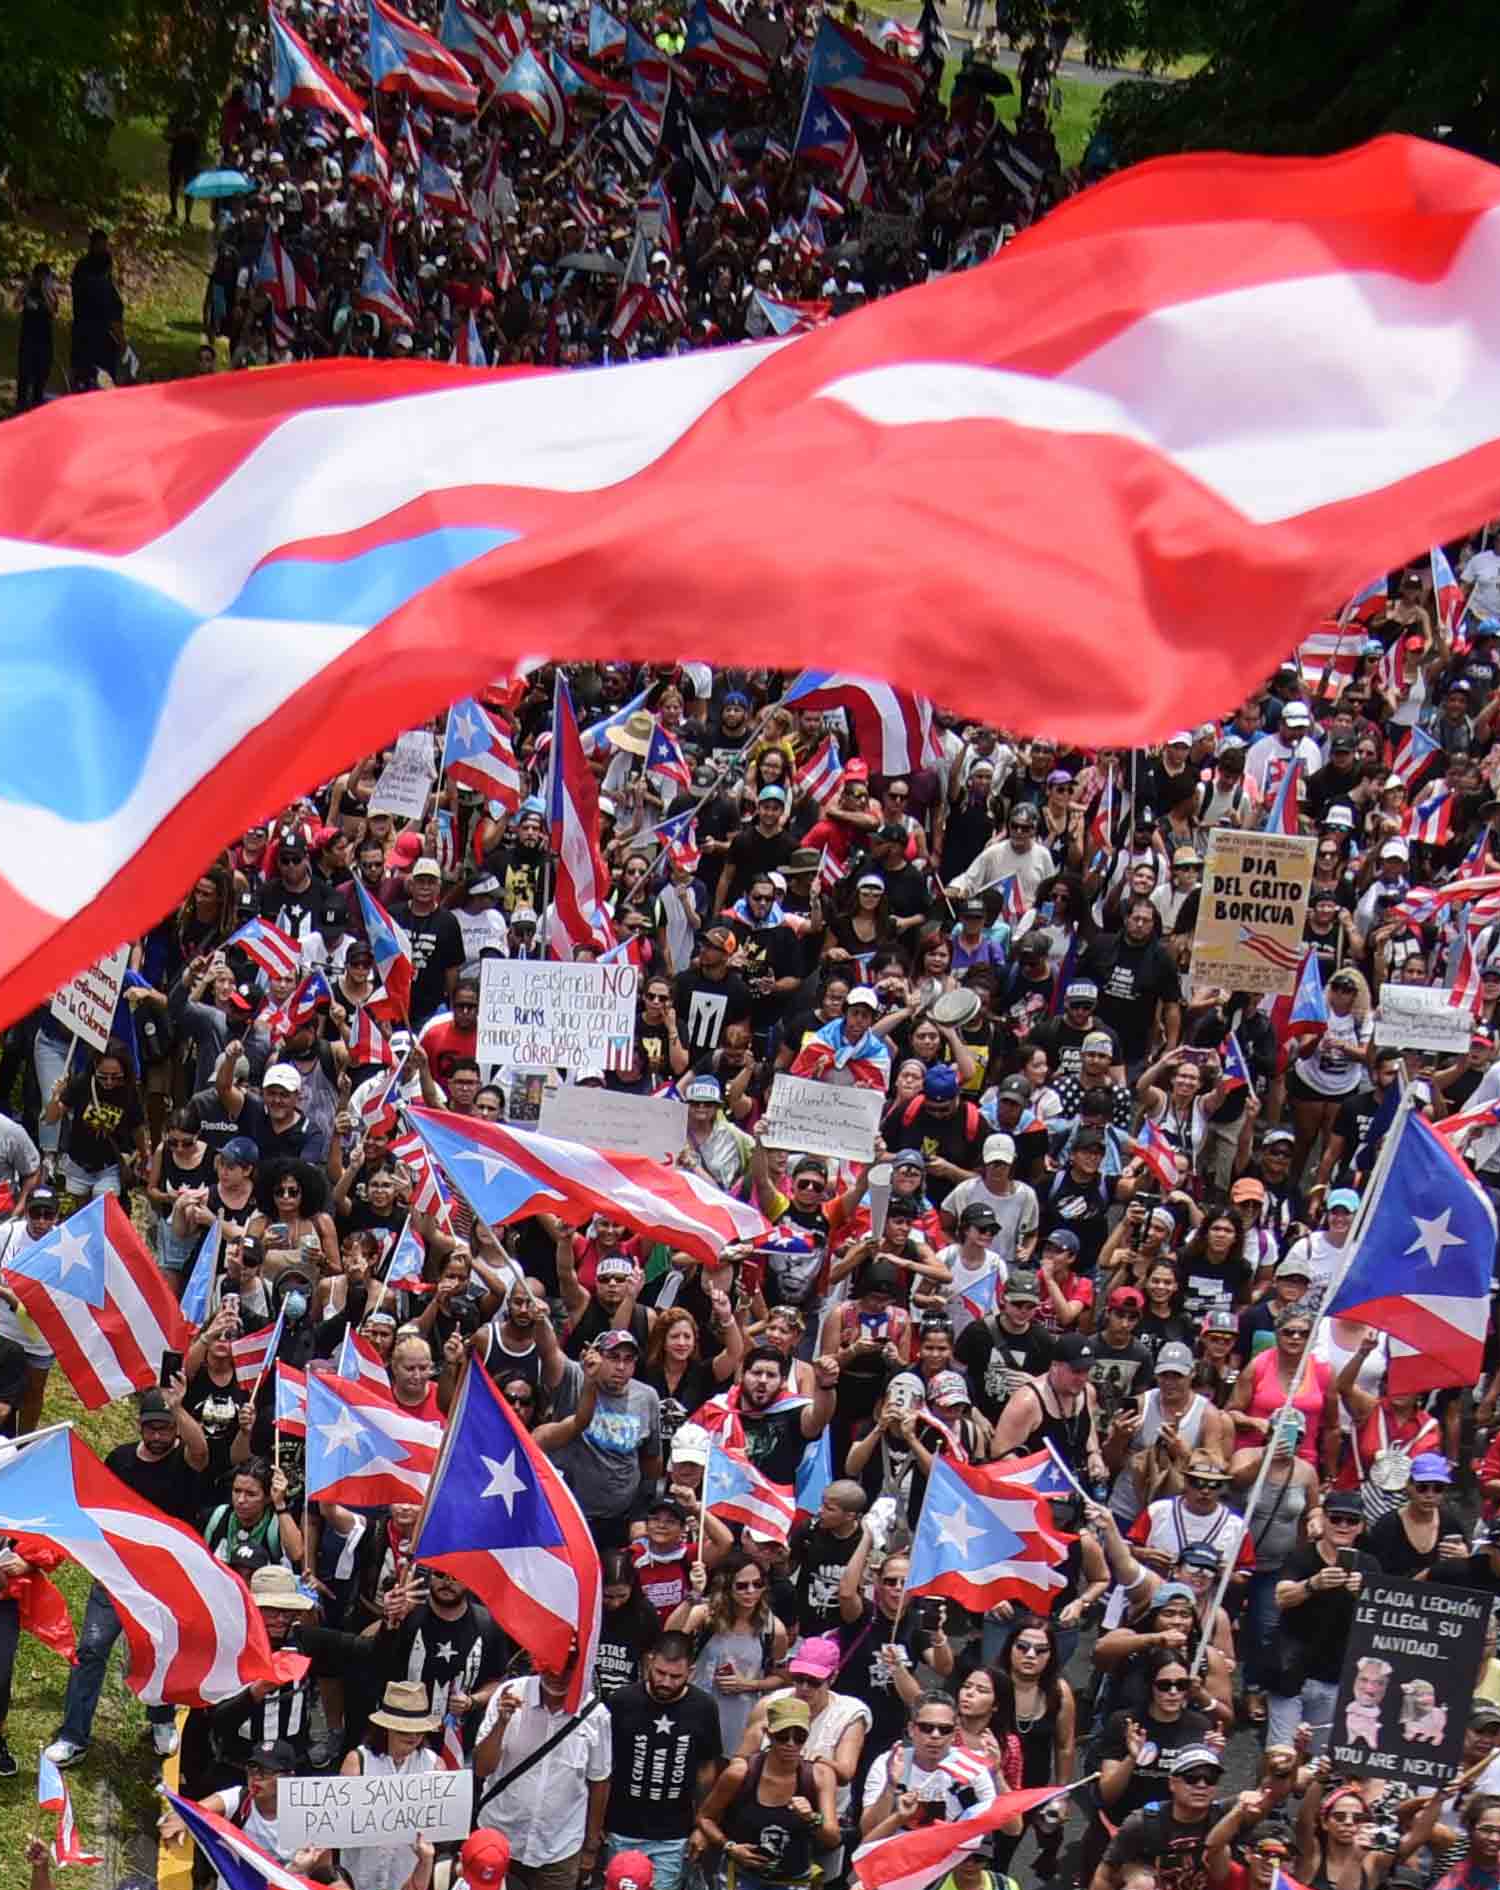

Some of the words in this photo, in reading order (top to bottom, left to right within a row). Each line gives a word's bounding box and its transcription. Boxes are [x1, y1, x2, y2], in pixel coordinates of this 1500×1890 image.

[1242, 857, 1277, 877] DIA
[1214, 876, 1242, 896] DEL
[1250, 880, 1302, 901] GRITO
[1214, 901, 1294, 926] BORICUA
[602, 967, 635, 998] NO
[1360, 1588, 1370, 1601] A
[1374, 1589, 1415, 1610] CADA
[1421, 1595, 1483, 1619] LECHÓN
[1356, 1608, 1376, 1624] LE
[1382, 1612, 1429, 1632] LLEGA
[1439, 1621, 1462, 1638] SU
[1334, 1747, 1363, 1764] YOU
[1366, 1754, 1398, 1770] ARE
[288, 1780, 352, 1808] ELIAS
[360, 1775, 457, 1806] SANCHEZ
[305, 1811, 340, 1833] PA'
[351, 1811, 379, 1834] LA
[381, 1805, 450, 1833] CARCEL
